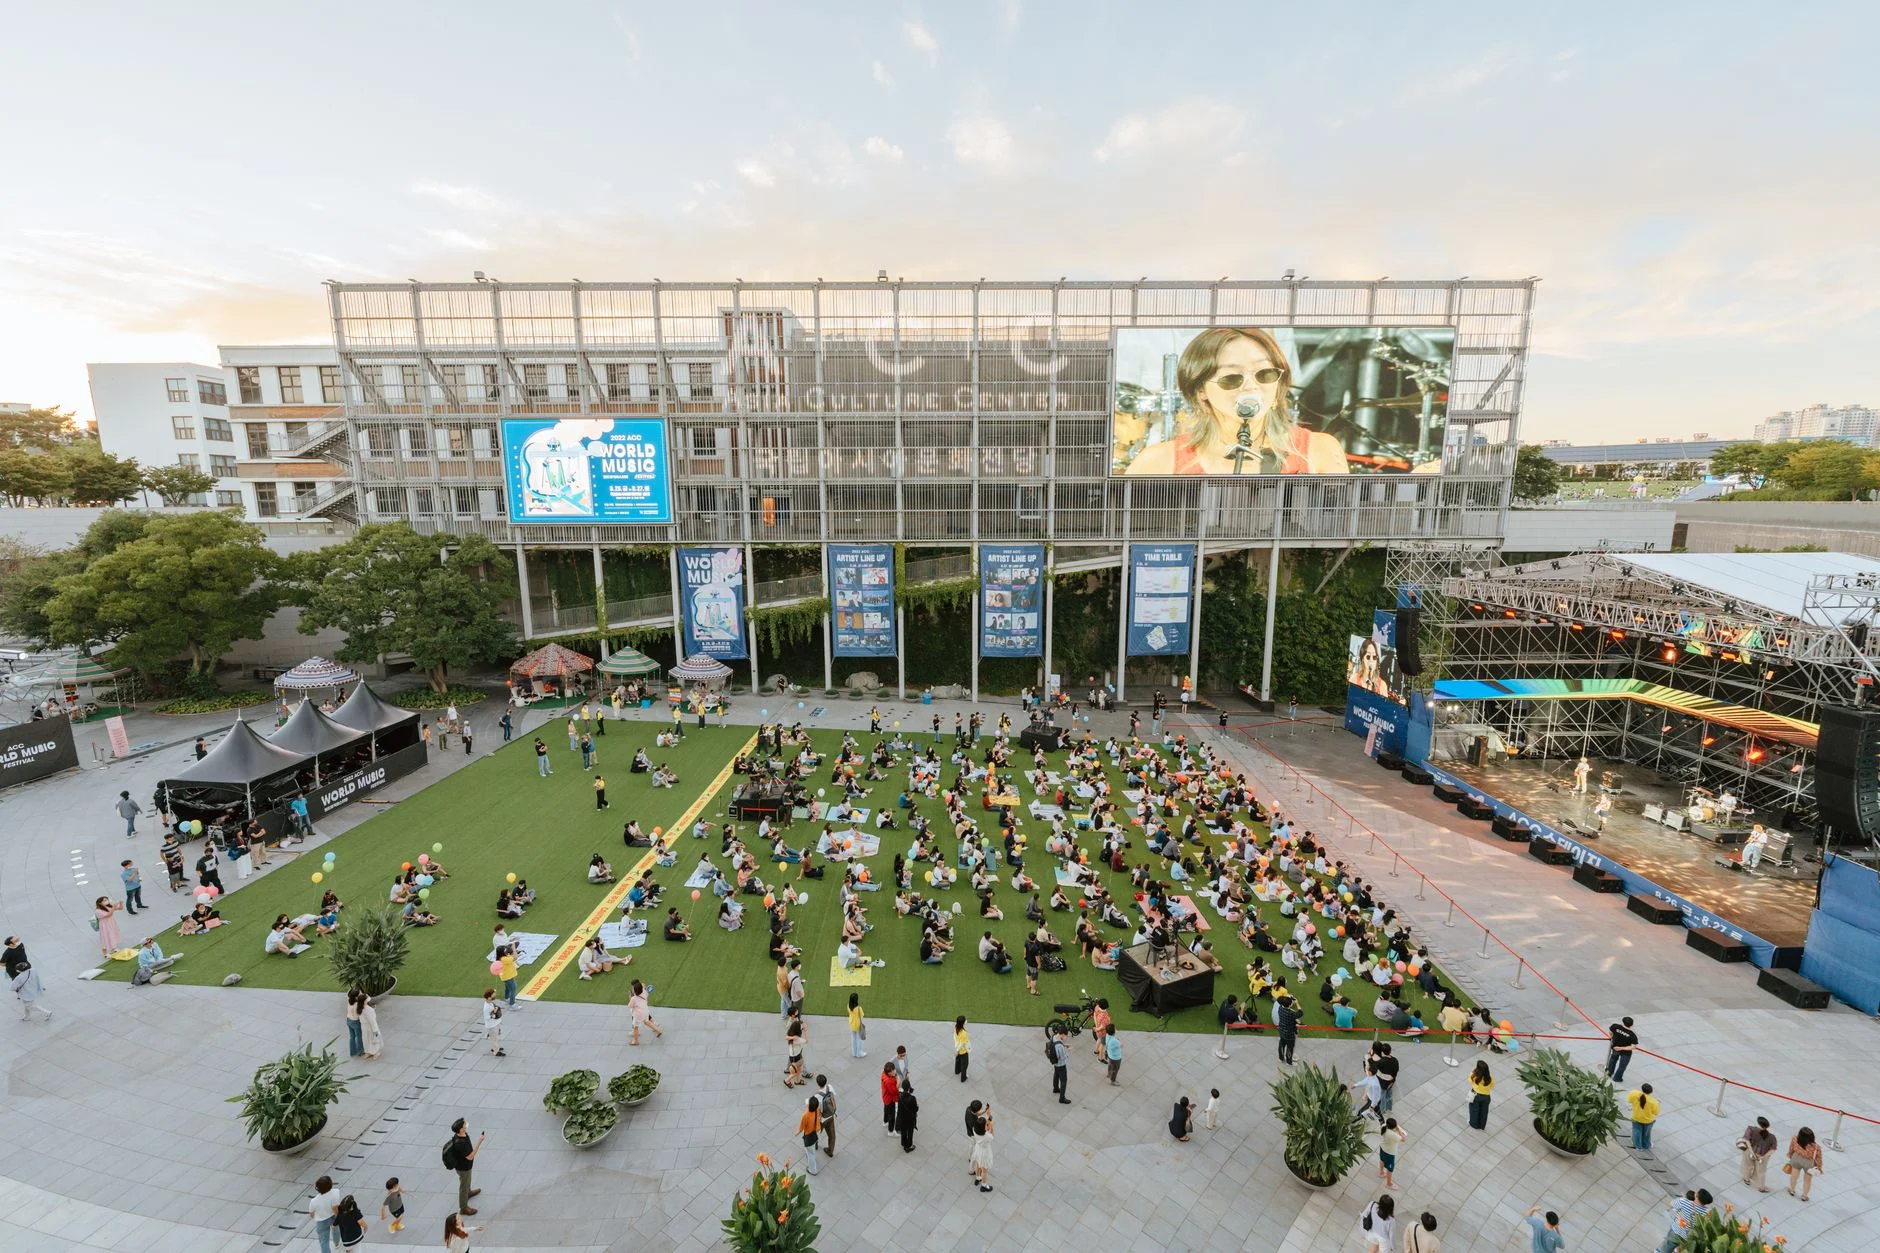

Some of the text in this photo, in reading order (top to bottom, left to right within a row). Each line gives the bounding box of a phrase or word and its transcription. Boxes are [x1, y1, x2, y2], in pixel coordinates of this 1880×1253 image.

[600, 443, 656, 458] WORLD
[602, 458, 655, 473] MUSIC
[836, 554, 886, 562] ARTIST LINE UP
[988, 554, 1037, 563] ARTIST LINE UP
[1144, 553, 1183, 561] TIME TABLE
[1353, 704, 1373, 723] WORLD
[1373, 715, 1395, 733] MUSIC
[8, 743, 24, 752] ACC
[21, 741, 57, 758] MUSIC
[3, 757, 35, 769] FESTIVAL
[353, 770, 364, 779] ACC
[320, 782, 356, 807] WORLD
[357, 767, 386, 789] MUSIC
